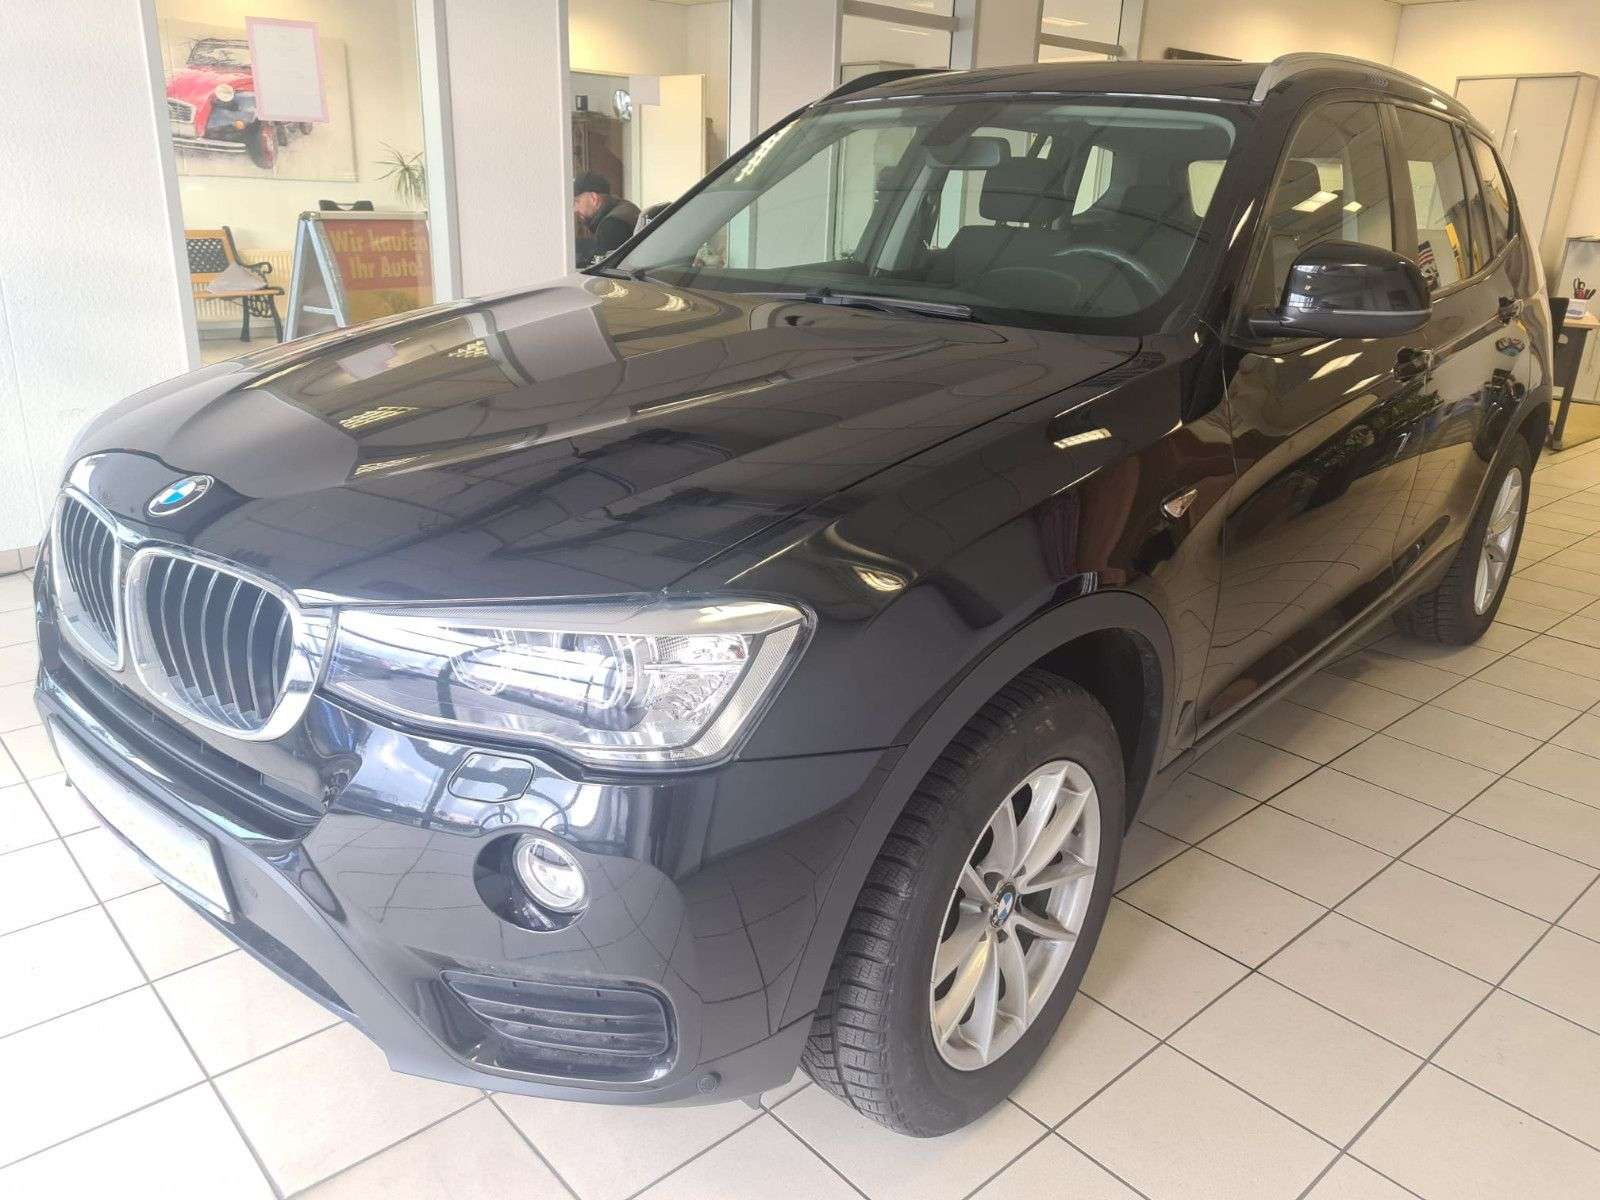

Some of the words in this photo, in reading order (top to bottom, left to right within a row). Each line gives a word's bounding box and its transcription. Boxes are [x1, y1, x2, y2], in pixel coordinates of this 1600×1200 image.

[329, 228, 364, 253] Wir
[367, 228, 428, 253] kaufen
[351, 255, 374, 279] Ihr
